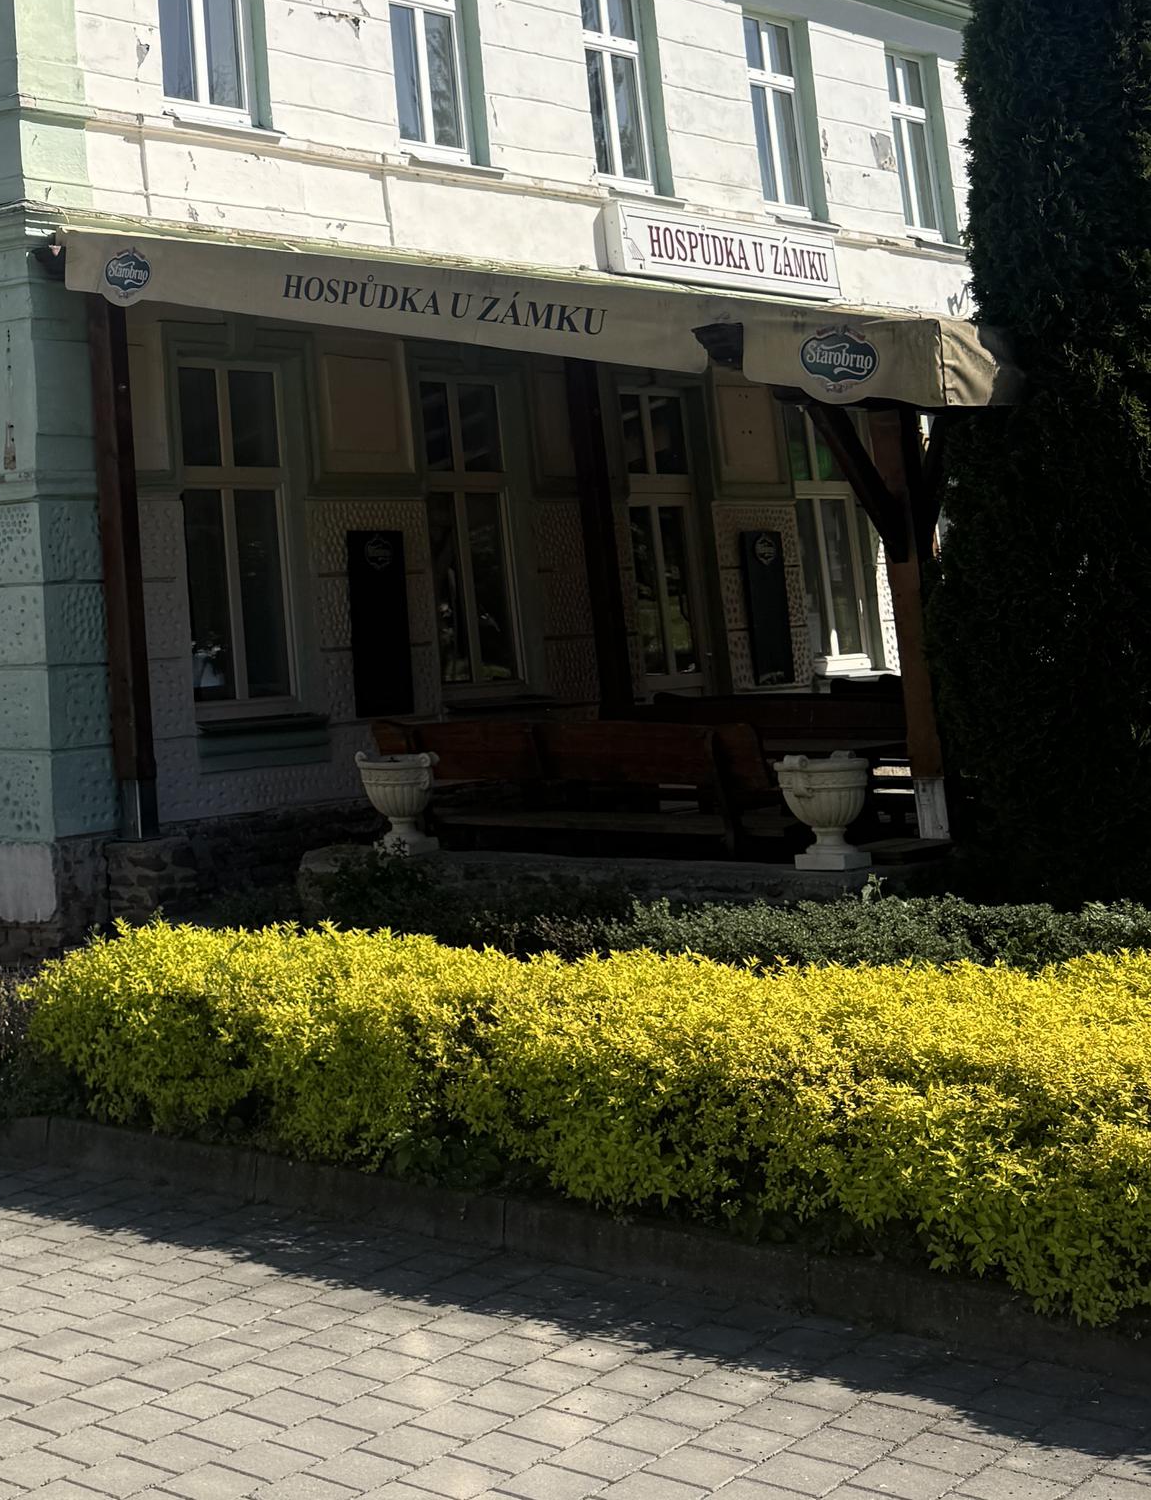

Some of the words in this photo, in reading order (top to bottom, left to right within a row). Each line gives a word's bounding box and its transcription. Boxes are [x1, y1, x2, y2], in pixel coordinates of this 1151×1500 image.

[108, 260, 149, 286] Starobrno
[648, 224, 750, 271] HOSPŮDKA
[752, 241, 765, 273] U
[770, 236, 829, 283] ZÁMKU
[282, 274, 441, 316] HOSPŮDKA
[450, 291, 473, 319] U
[476, 291, 608, 336] ZÁMKU
[806, 339, 874, 376] Starobrno
